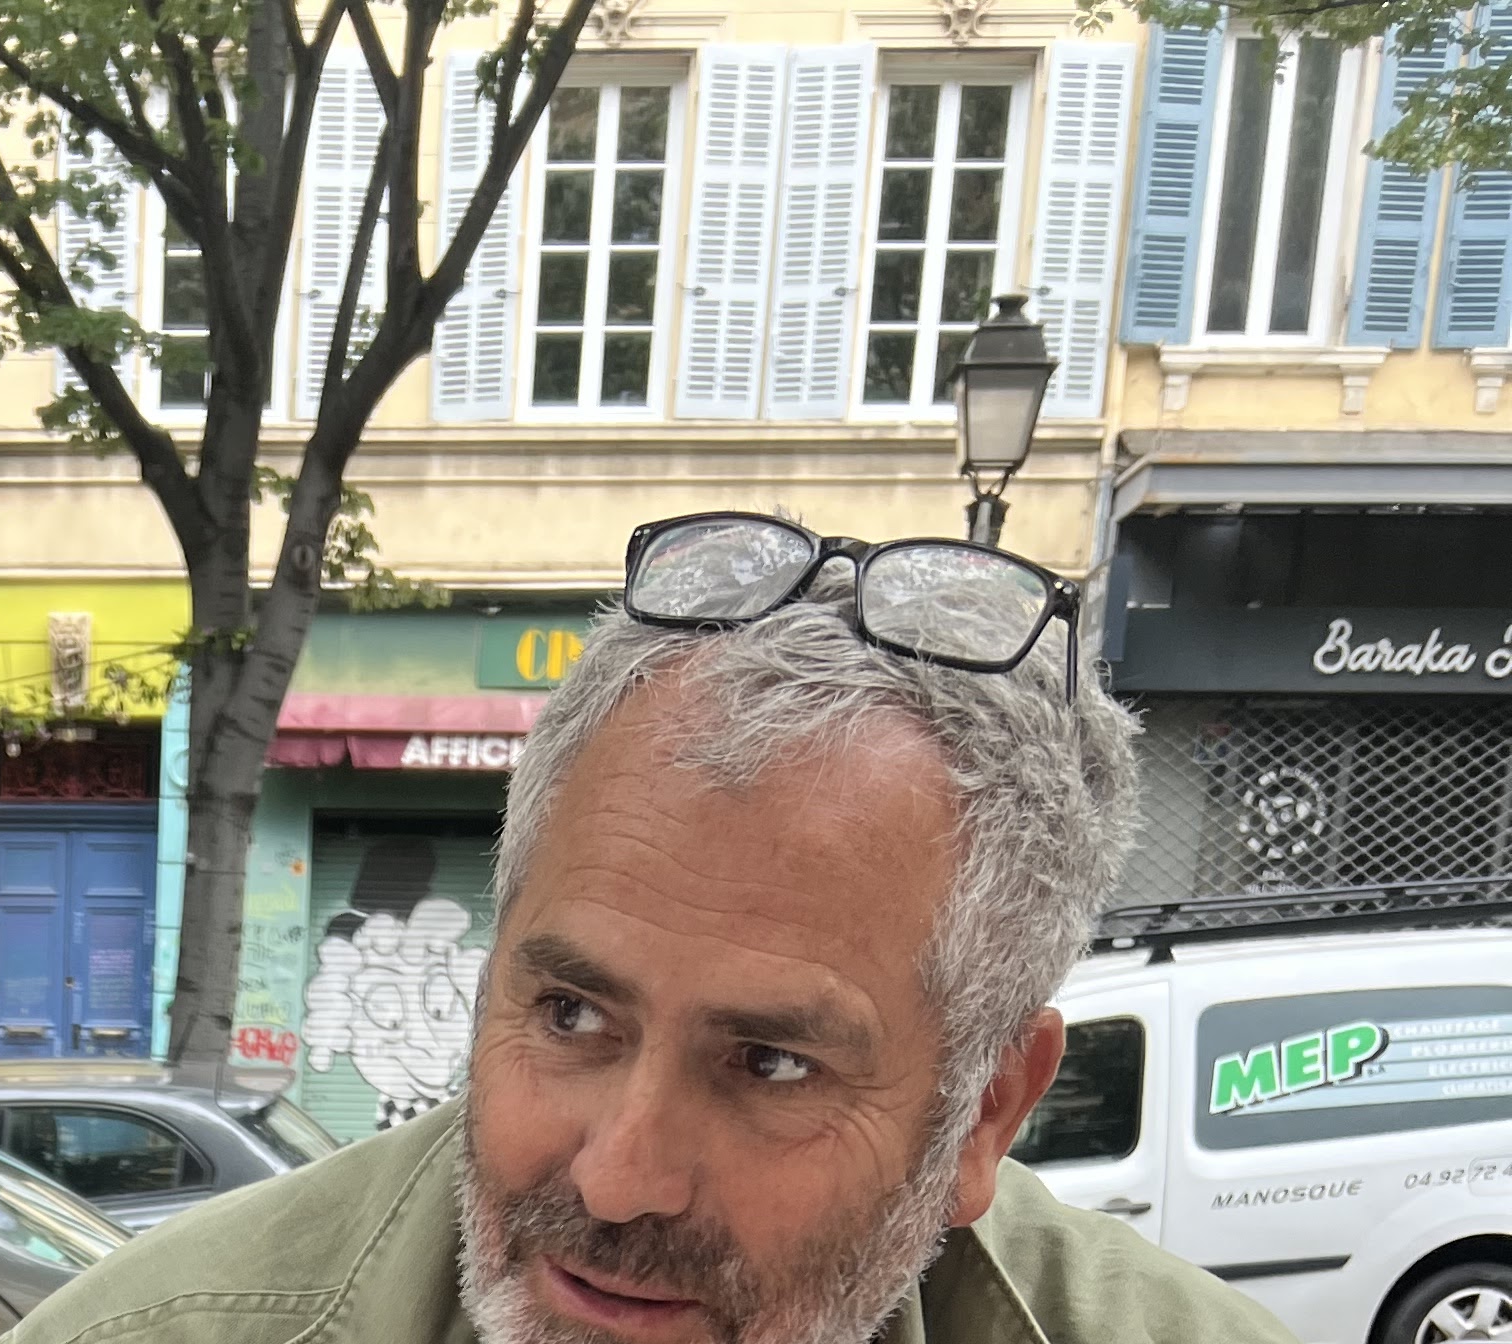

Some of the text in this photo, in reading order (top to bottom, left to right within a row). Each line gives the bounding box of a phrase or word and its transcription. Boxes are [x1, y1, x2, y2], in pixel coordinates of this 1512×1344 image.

[1313, 618, 1477, 675] Baraka
[1209, 1021, 1381, 1114] MEP
[1211, 1179, 1363, 1209] MANOSQUE
